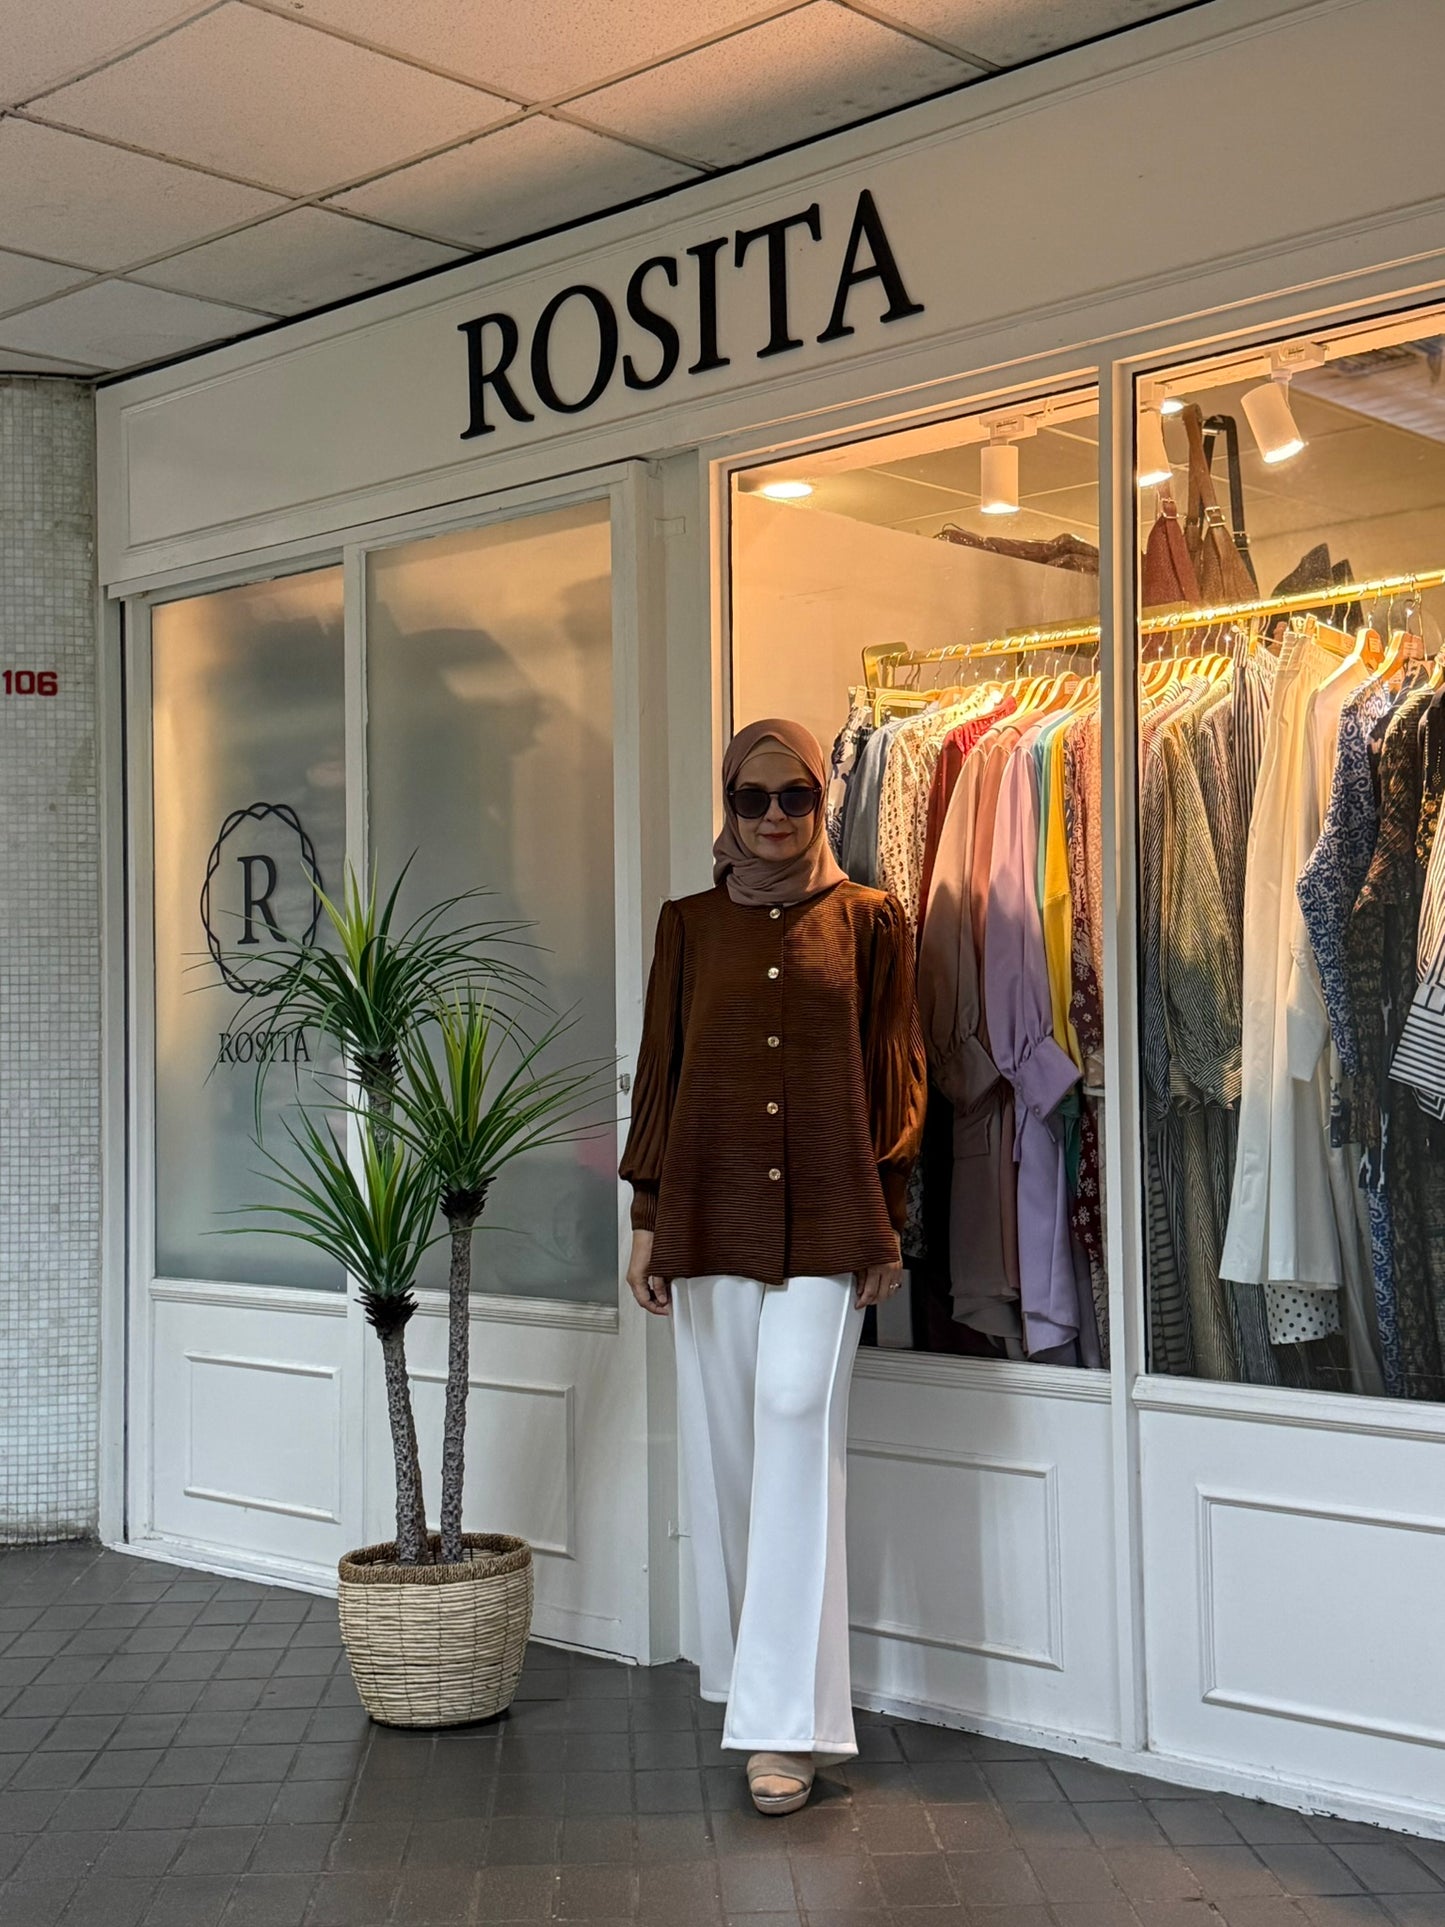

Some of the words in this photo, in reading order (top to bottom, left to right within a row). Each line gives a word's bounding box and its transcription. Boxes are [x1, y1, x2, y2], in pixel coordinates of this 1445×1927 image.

[457, 188, 925, 440] ROSITA
[2, 669, 58, 697] 106
[237, 855, 287, 945] R
[218, 1030, 312, 1063] ROSITA
